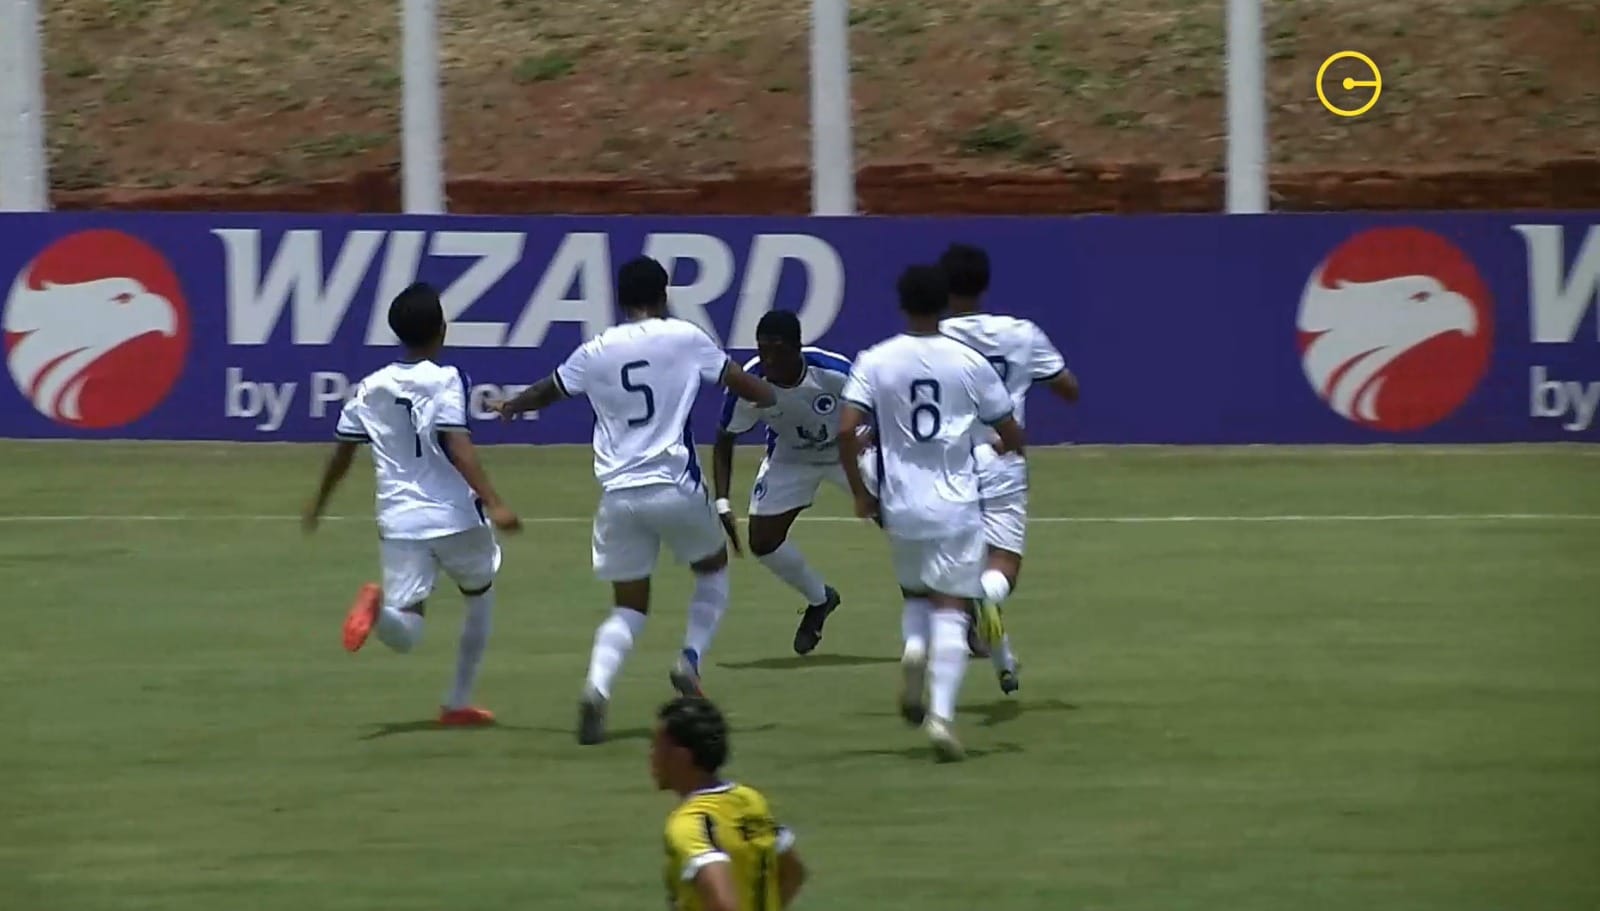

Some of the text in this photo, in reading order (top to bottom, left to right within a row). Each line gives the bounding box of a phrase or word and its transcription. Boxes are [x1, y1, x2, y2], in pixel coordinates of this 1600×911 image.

[210, 229, 845, 349] WIZARD
[225, 367, 298, 432] by
[620, 360, 655, 427] 5
[1529, 366, 1600, 431] by
